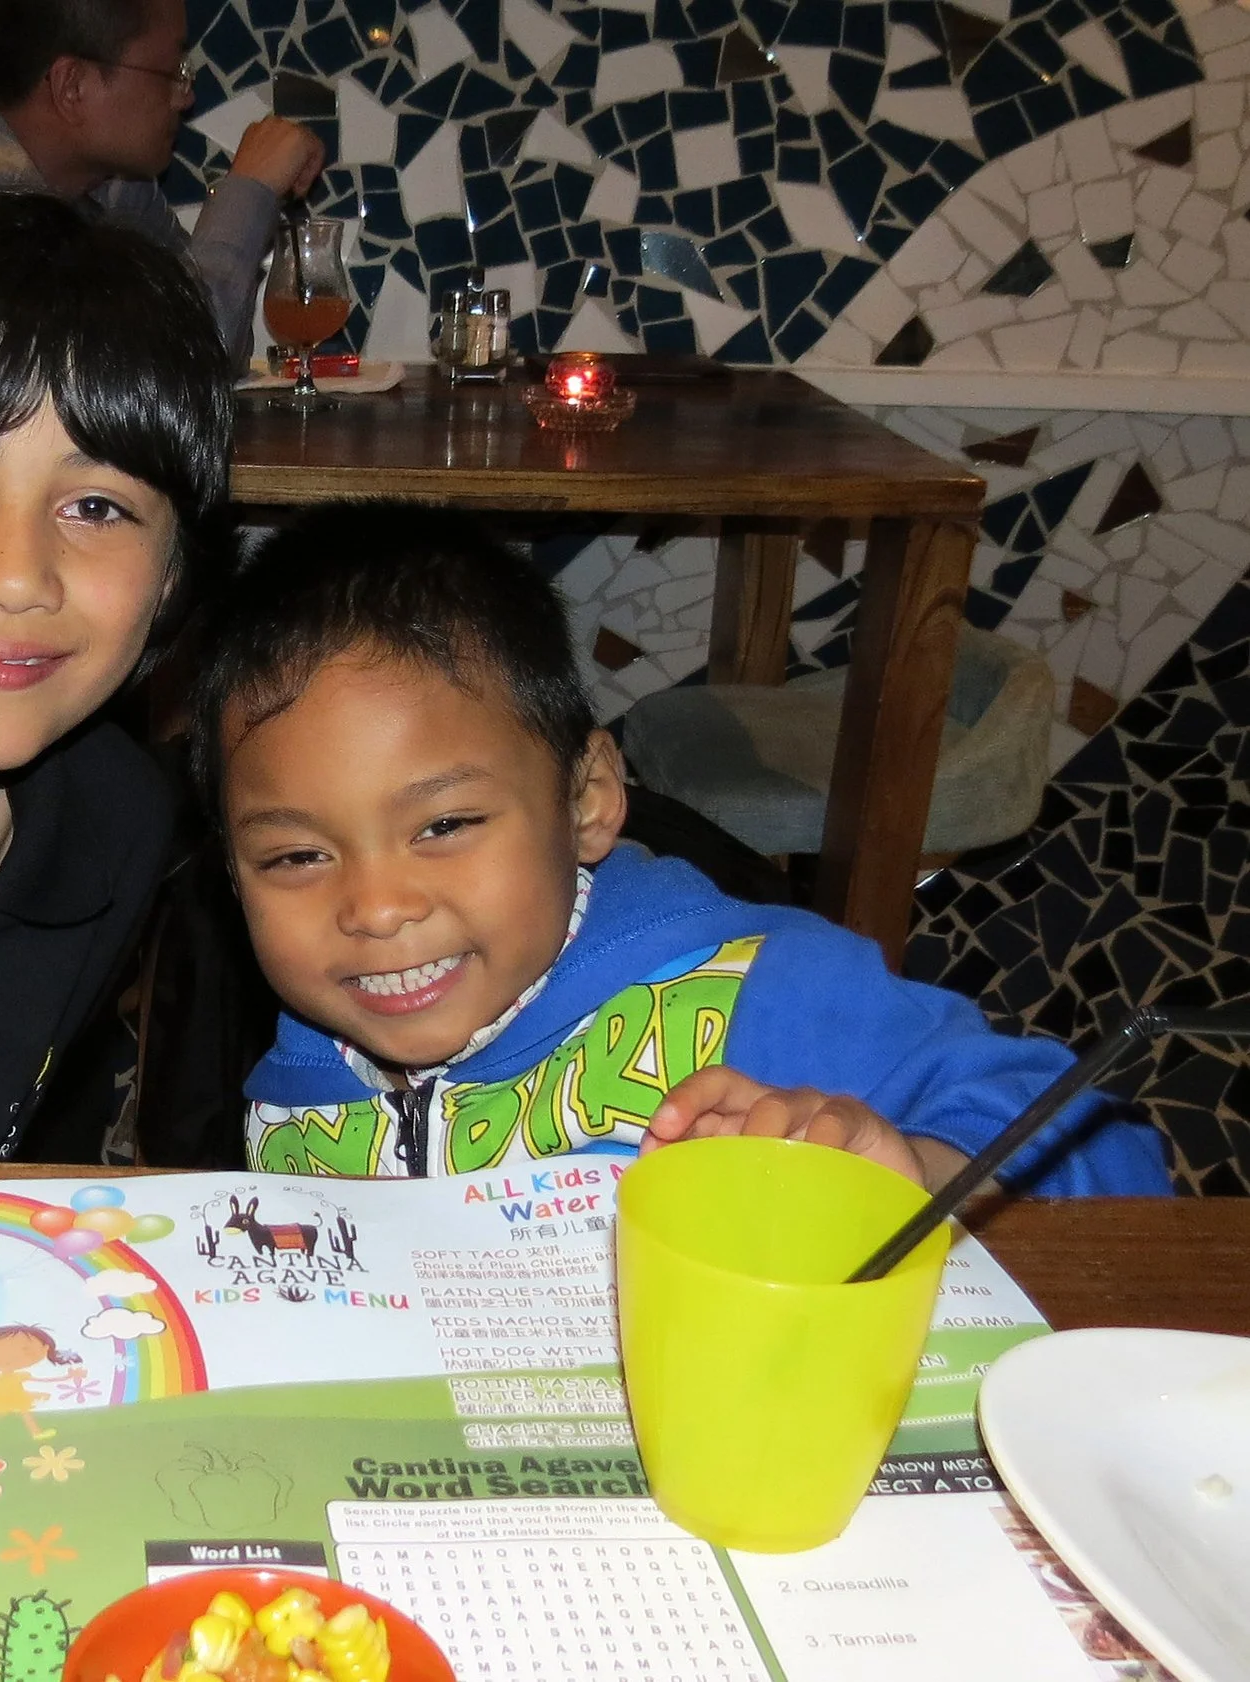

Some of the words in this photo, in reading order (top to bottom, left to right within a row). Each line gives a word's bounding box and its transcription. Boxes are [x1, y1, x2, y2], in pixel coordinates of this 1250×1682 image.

[464, 1178, 524, 1204] ALL
[531, 1168, 601, 1193] Kids
[499, 1194, 601, 1222] Water
[411, 1250, 459, 1259] SOFT
[468, 1249, 519, 1259] TACO
[208, 1252, 369, 1272] CANTINA
[490, 1259, 525, 1269] Plain
[530, 1255, 590, 1269] Chicken
[944, 1259, 970, 1268] MB
[232, 1269, 345, 1286] AGAVE
[421, 1287, 482, 1297] PLAIN
[950, 1285, 992, 1296] RMB
[195, 1288, 261, 1304] KIDS
[324, 1289, 410, 1309] MENU
[431, 1316, 480, 1326] KIDS
[487, 1316, 573, 1326] NACHOS
[943, 1317, 966, 1328] 40
[972, 1316, 1014, 1327] RMB
[440, 1347, 484, 1358] HOT
[493, 1346, 535, 1356] DOG
[542, 1346, 603, 1356] WITH
[538, 1377, 607, 1388] PASTA
[455, 1391, 535, 1401] BUTTER
[352, 1457, 506, 1476] Cantina
[519, 1455, 639, 1477] Agave
[880, 1461, 935, 1474] KNOW
[345, 1476, 474, 1499] Word
[486, 1474, 650, 1496] Search
[934, 1479, 951, 1491] A
[955, 1476, 993, 1491] TO
[343, 1507, 389, 1516] Search
[512, 1504, 551, 1513] words
[555, 1504, 597, 1512] shown
[450, 1517, 483, 1526] word
[190, 1545, 239, 1560] Word
[246, 1545, 281, 1559] List
[803, 1577, 909, 1592] Quesadilla
[829, 1632, 917, 1647] Tamales
